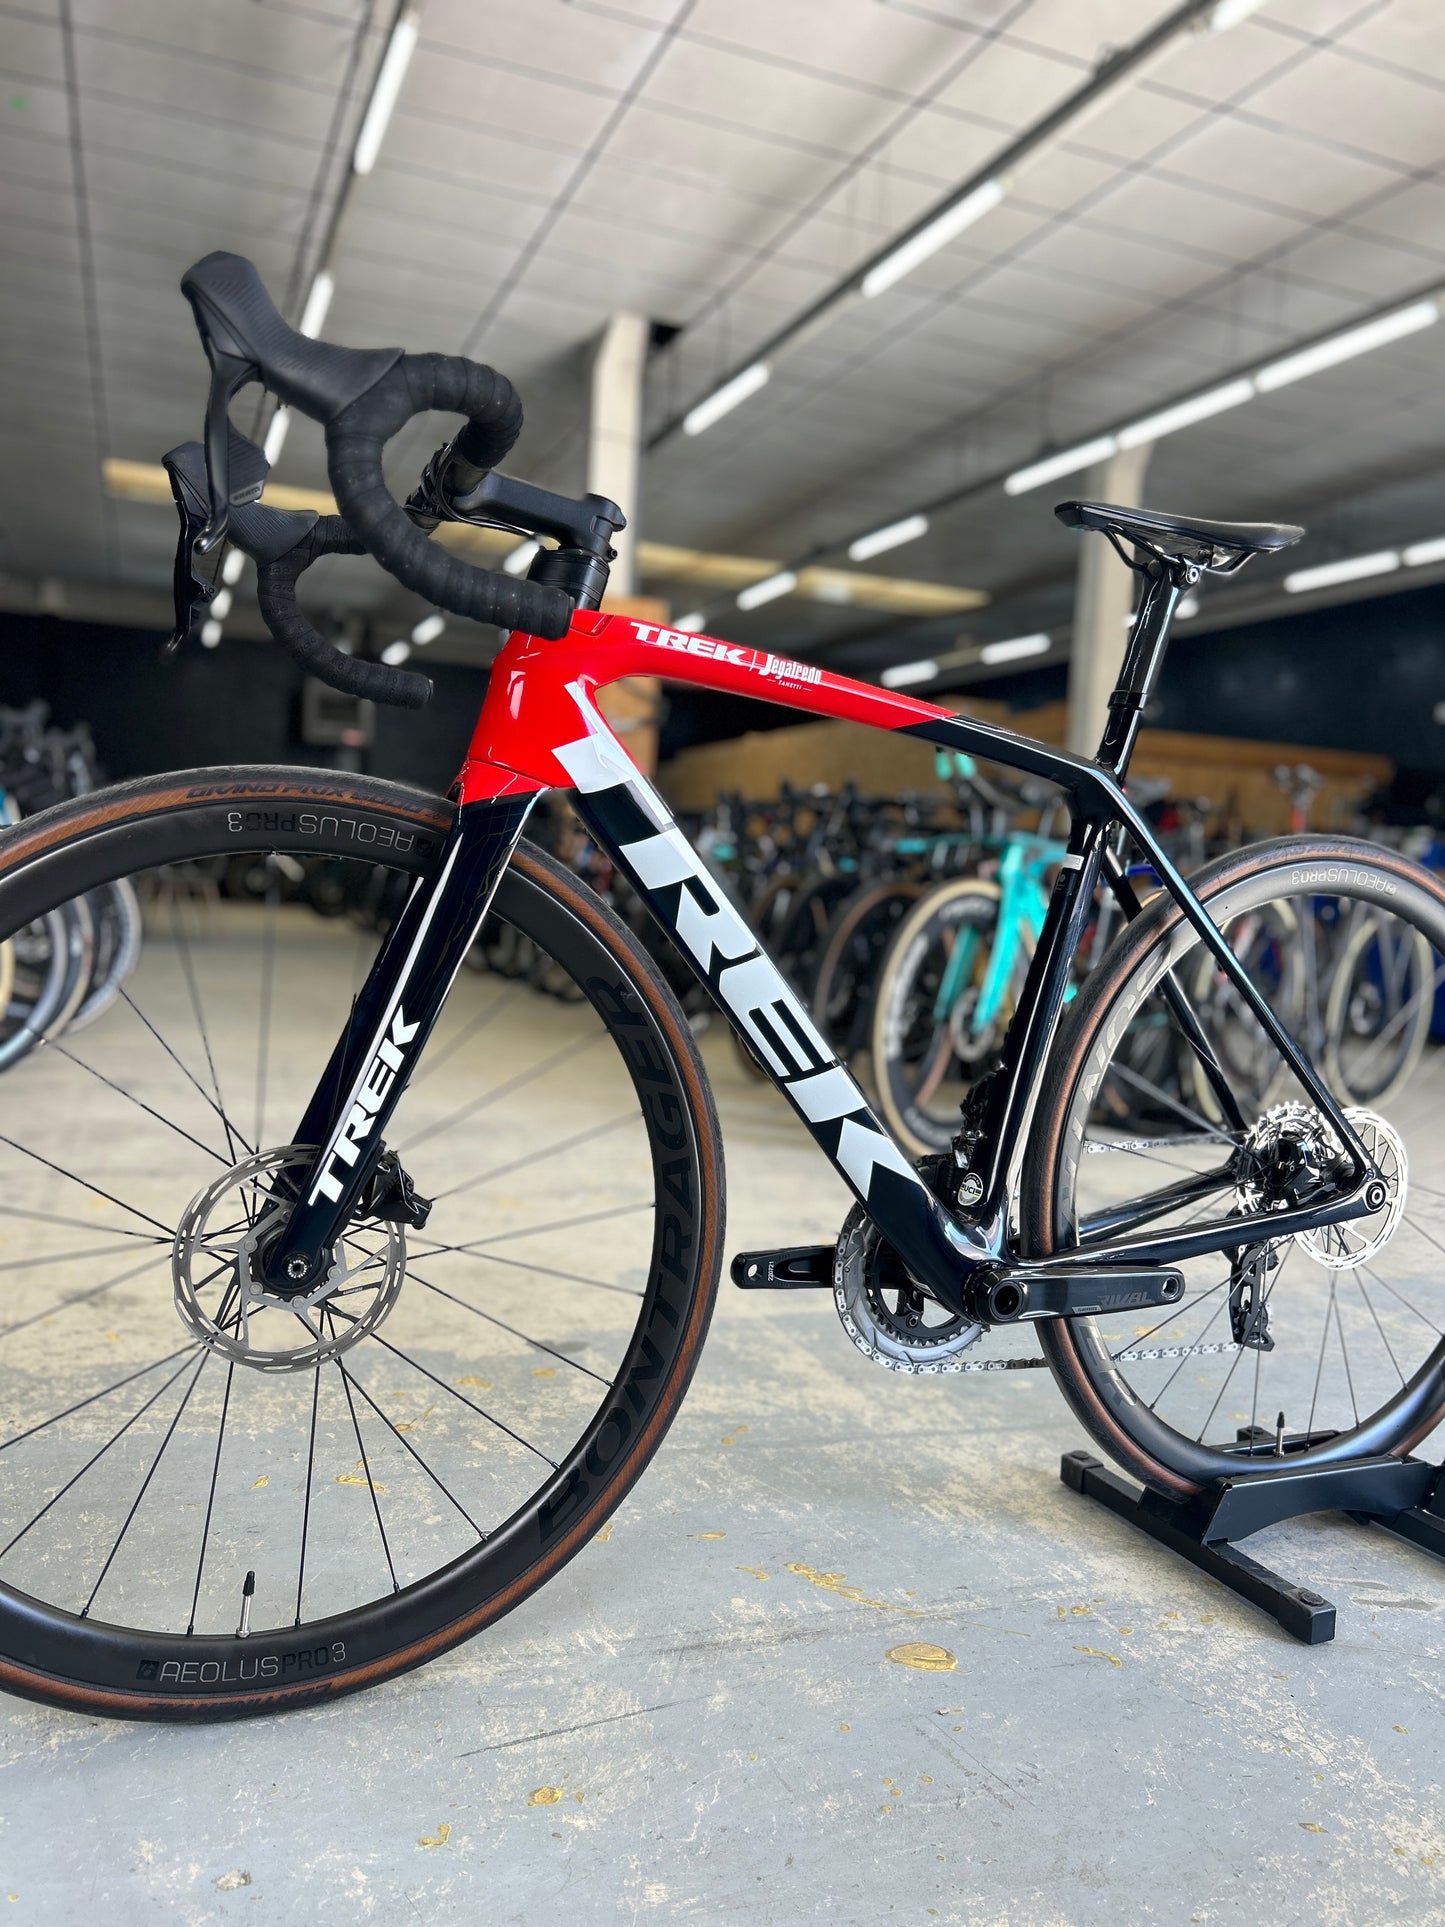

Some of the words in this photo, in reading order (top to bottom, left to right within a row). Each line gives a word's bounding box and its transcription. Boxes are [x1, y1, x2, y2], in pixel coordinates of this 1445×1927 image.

[630, 622, 747, 666] TREK
[758, 654, 822, 685] Segafredo
[777, 680, 802, 690] ZANETTI
[187, 783, 281, 798] GRAND
[282, 784, 344, 798] PRIX
[551, 682, 922, 1202] TREK
[307, 1004, 420, 1207] TREK
[537, 976, 695, 1545] BONTRAGER
[1097, 1291, 1156, 1306] RIVAL
